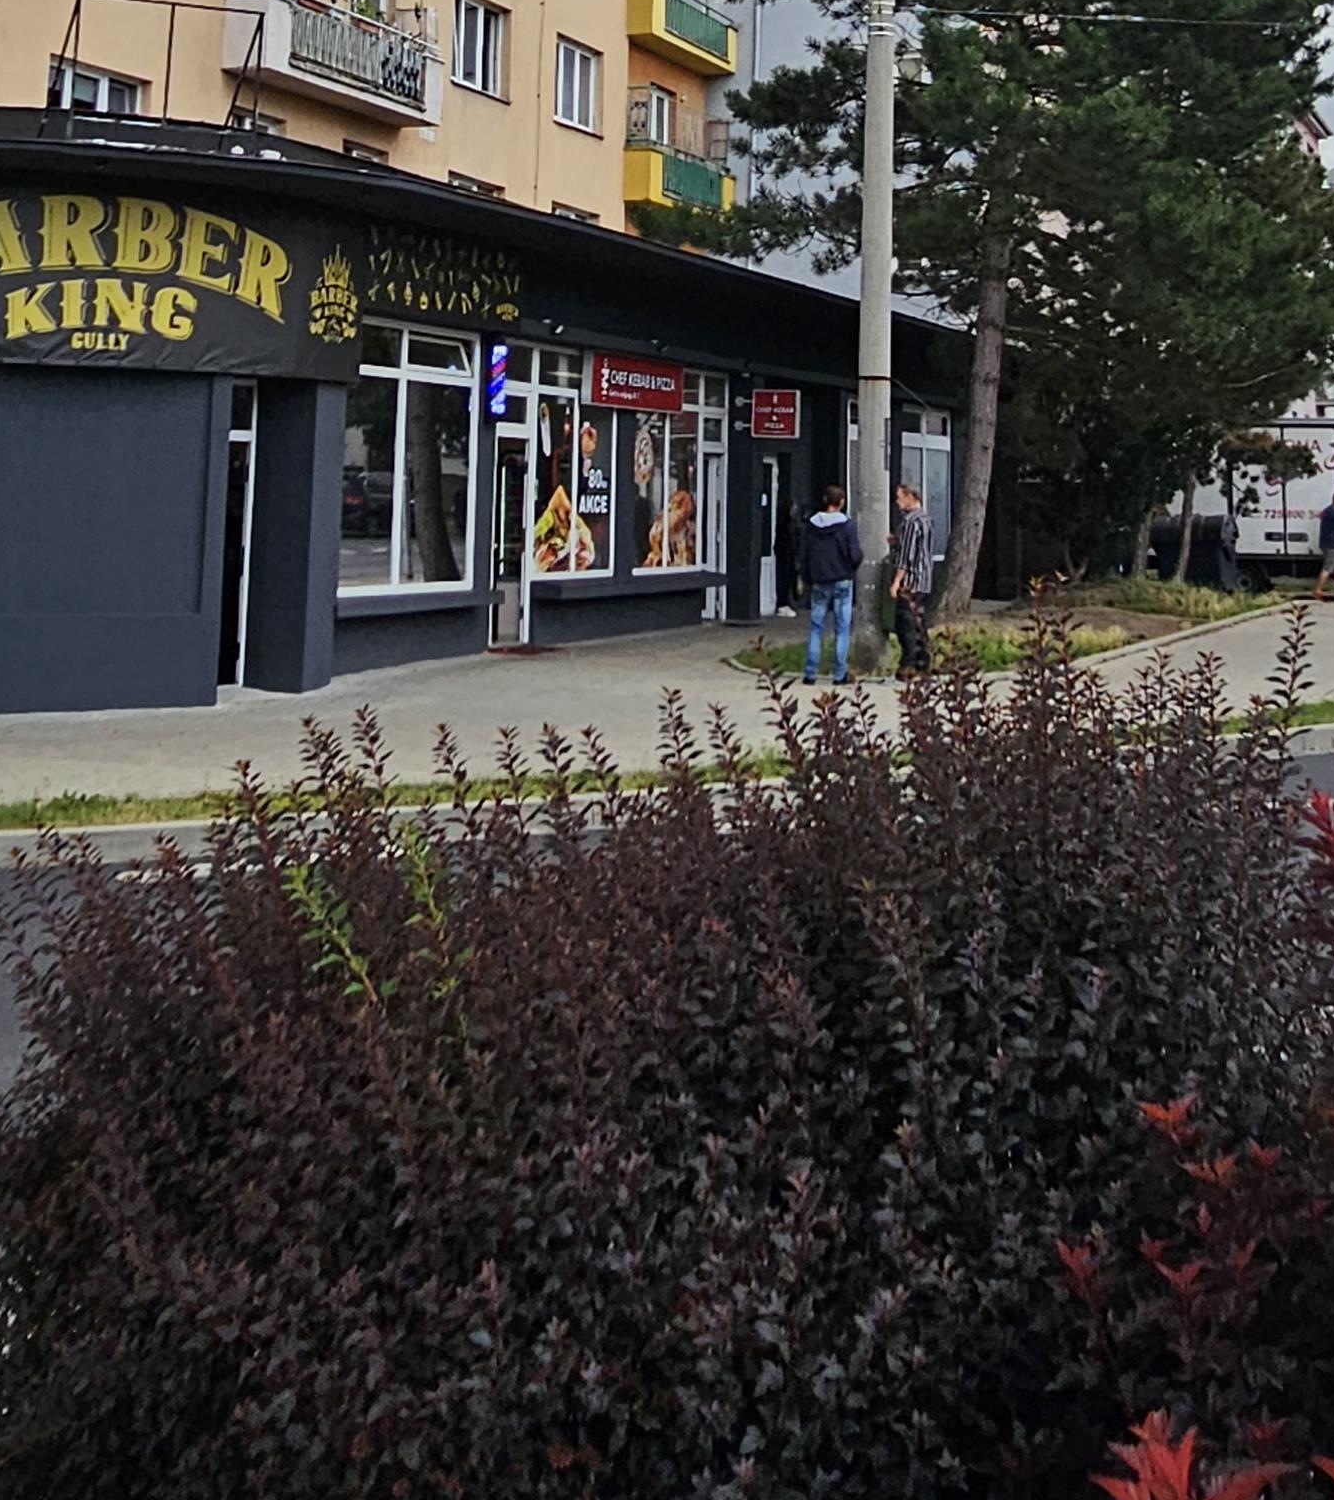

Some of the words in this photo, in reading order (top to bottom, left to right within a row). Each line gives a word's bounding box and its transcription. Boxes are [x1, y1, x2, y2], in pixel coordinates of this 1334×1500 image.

[4, 277, 198, 342] KING
[310, 287, 358, 313] BARBER
[71, 331, 130, 351] GULLY
[610, 369, 628, 386] CHEF
[628, 373, 651, 389] KEBAB
[656, 377, 676, 392] PIZZA
[579, 494, 608, 514] AKCE
